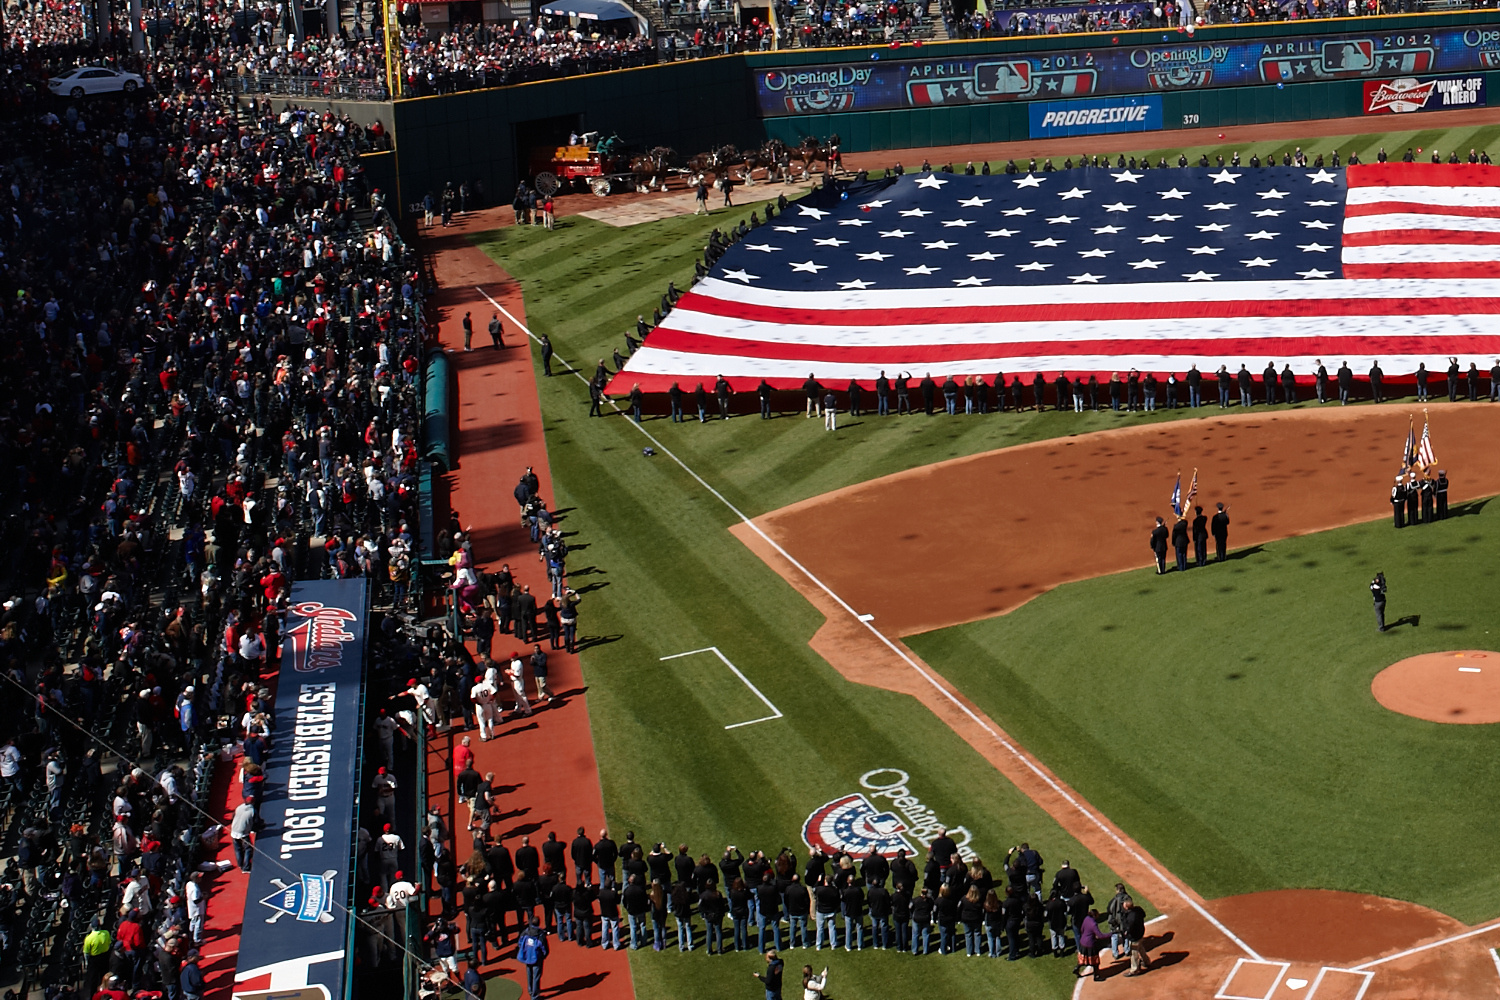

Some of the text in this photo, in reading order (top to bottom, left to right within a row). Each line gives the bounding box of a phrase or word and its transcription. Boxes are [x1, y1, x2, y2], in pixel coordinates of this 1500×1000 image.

[1384, 34, 1431, 47] 2012
[1263, 43, 1314, 55] APRIL
[1042, 55, 1093, 68] 2012
[1131, 45, 1228, 68] Opening Day
[911, 63, 967, 77] APRIL
[765, 67, 872, 91] Opening Day
[1369, 91, 1433, 103] Budweiser
[1443, 90, 1477, 105] A HERO
[1042, 105, 1149, 127] PROGRESSIVE
[1183, 114, 1199, 125] 370
[409, 203, 425, 212] 325
[480, 689, 488, 698] 10
[280, 682, 336, 860] ESTABLISHED 1901.
[284, 889, 296, 908] FIELD
[304, 877, 321, 918] PROGRESSIVE
[394, 890, 405, 900] 20
